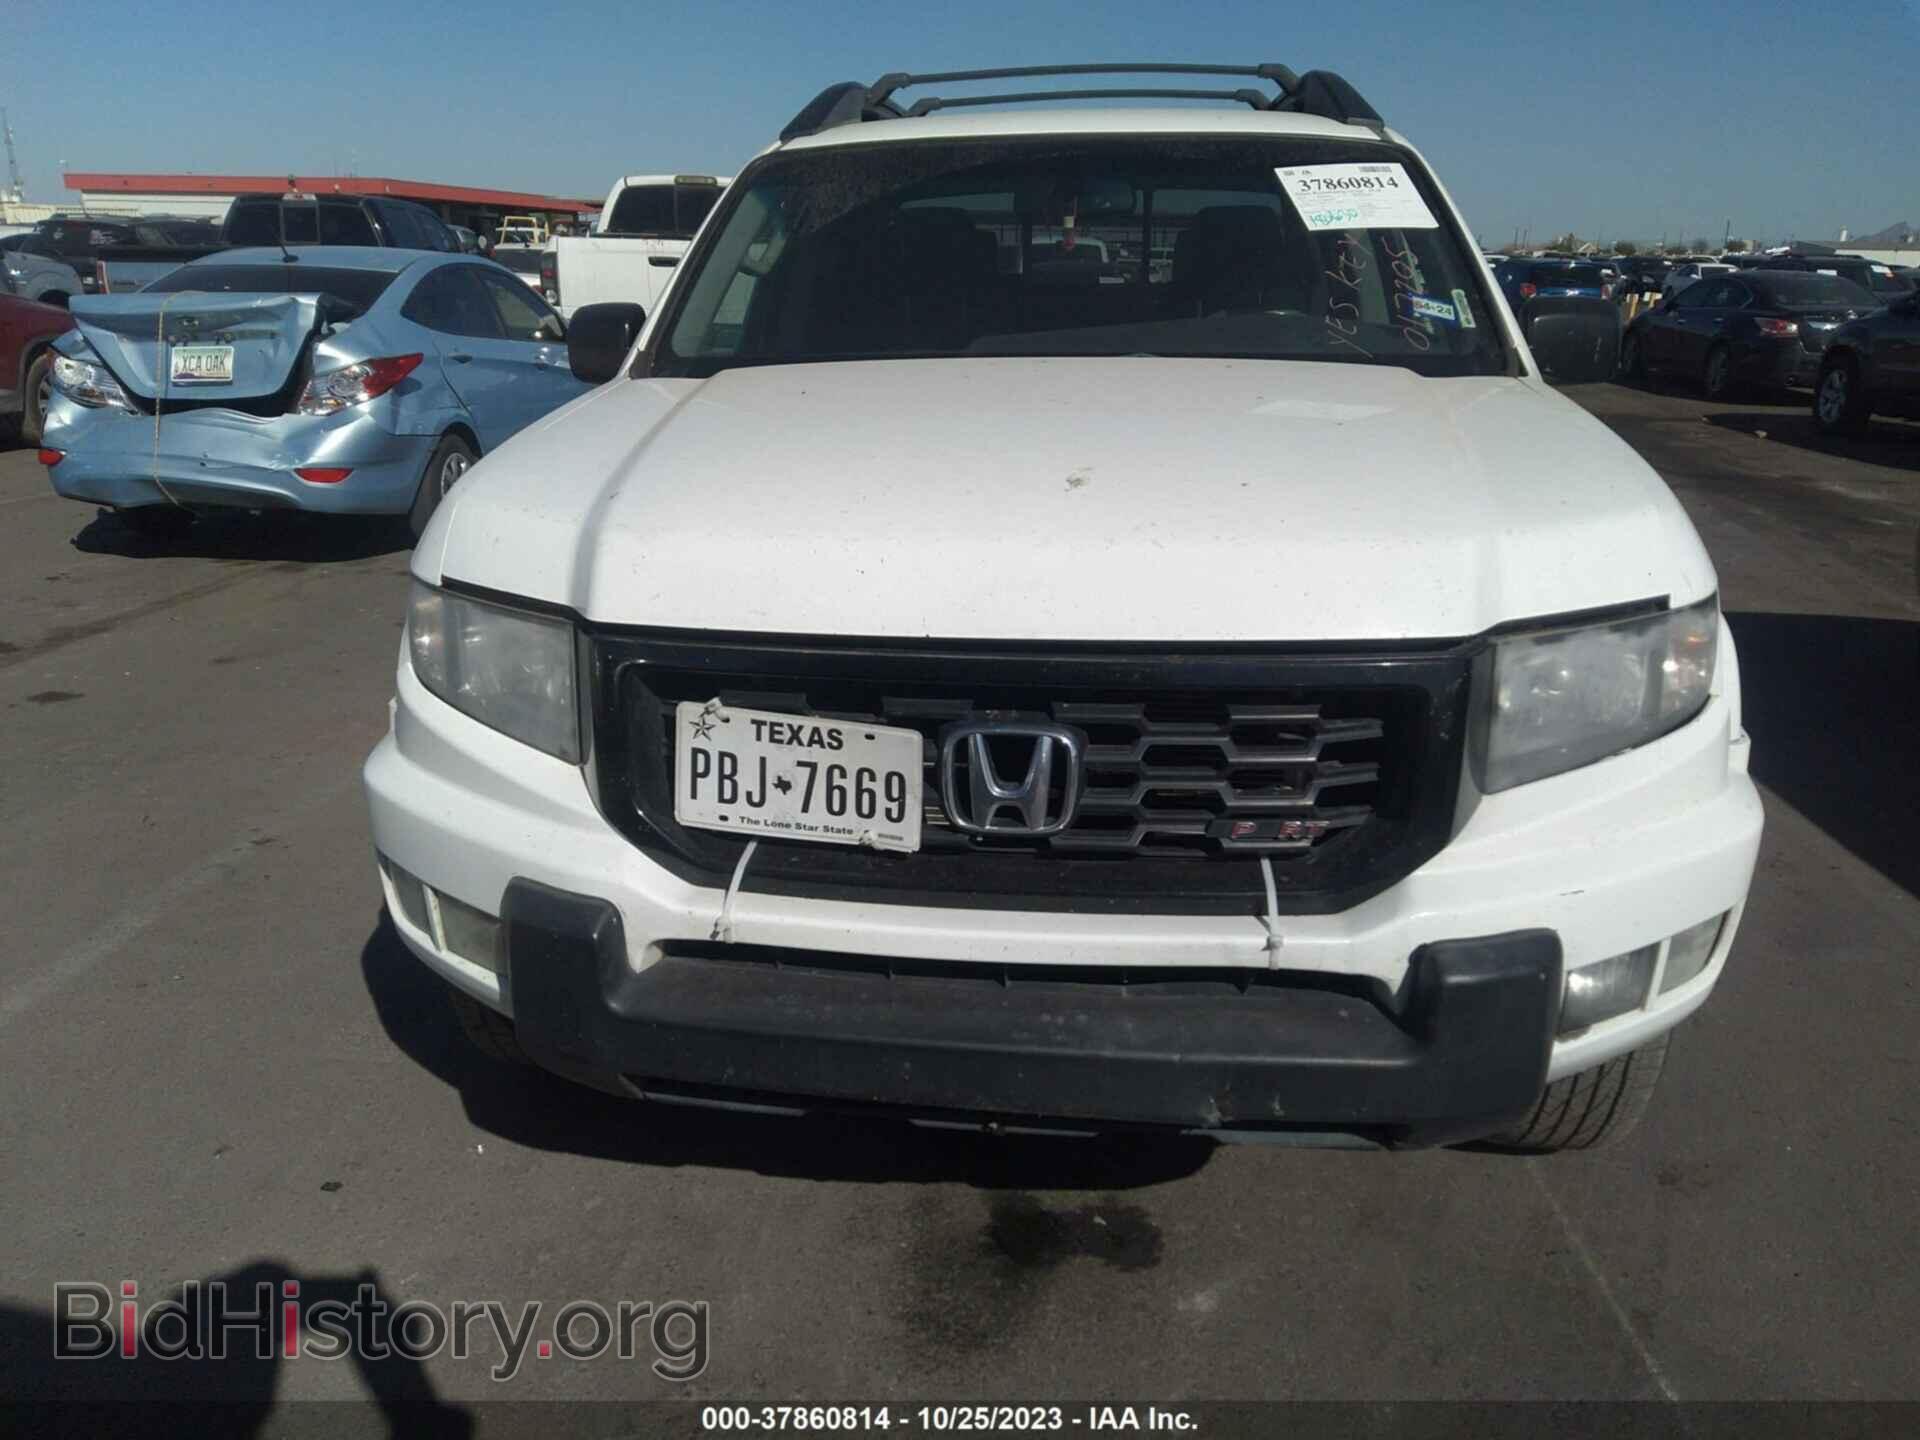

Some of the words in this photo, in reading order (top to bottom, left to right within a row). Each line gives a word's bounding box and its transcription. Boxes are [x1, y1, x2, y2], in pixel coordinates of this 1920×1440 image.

[1298, 176, 1399, 192] 37860814
[750, 719, 845, 750] TEXAS
[689, 746, 767, 808] PBJ
[796, 760, 907, 824] 7669
[739, 816, 760, 826] The
[764, 819, 792, 830] Lone
[795, 822, 819, 833] Star
[823, 825, 854, 835] State
